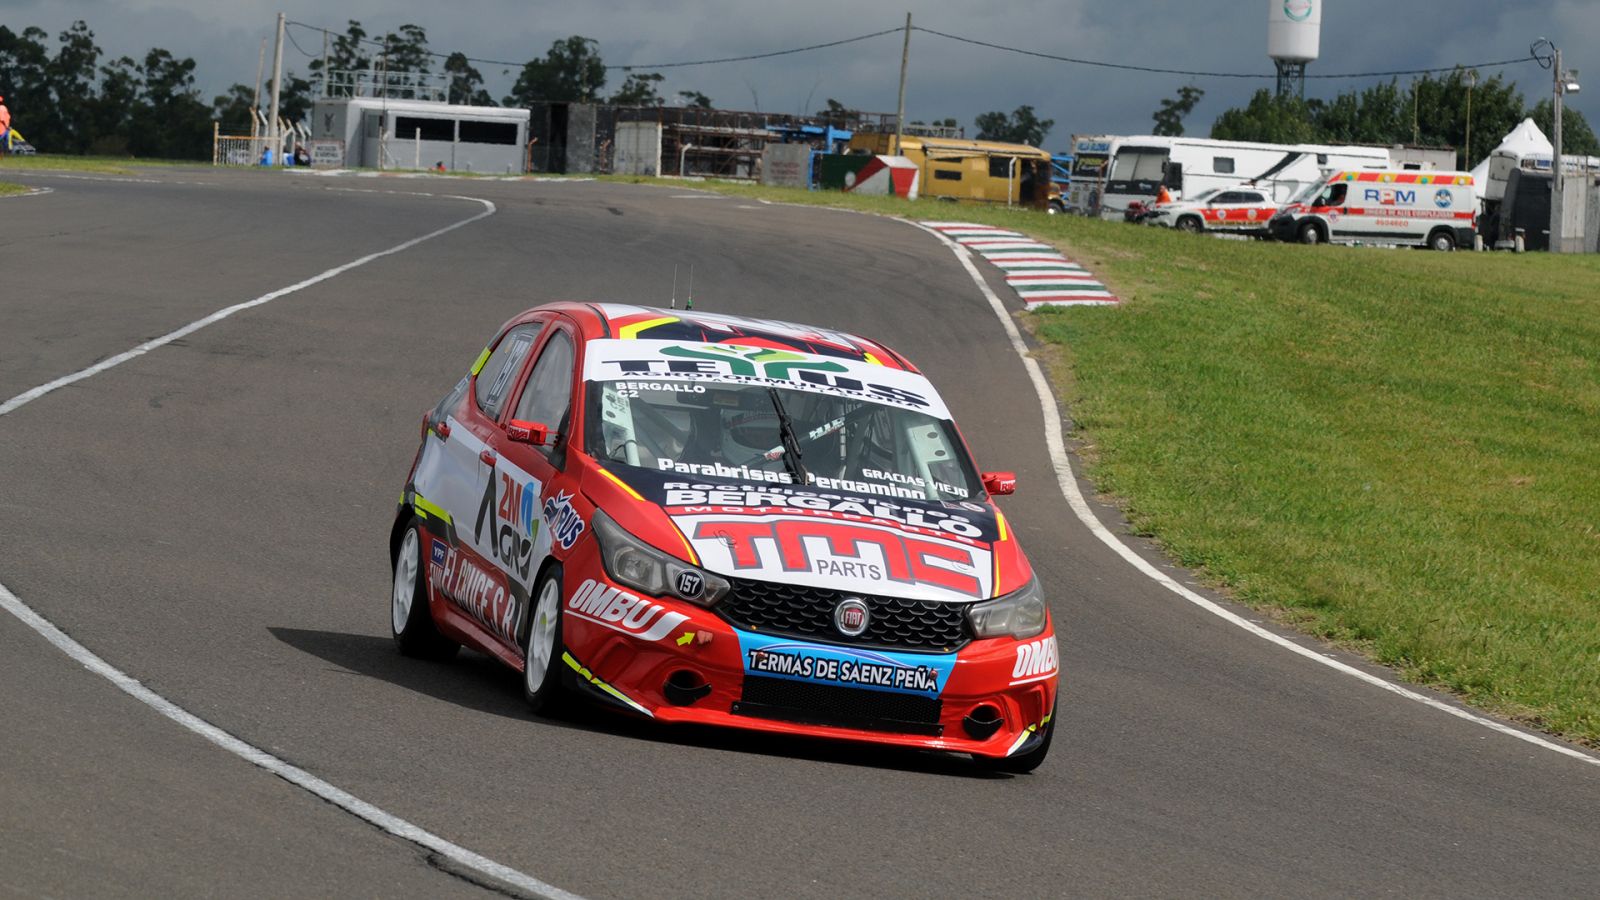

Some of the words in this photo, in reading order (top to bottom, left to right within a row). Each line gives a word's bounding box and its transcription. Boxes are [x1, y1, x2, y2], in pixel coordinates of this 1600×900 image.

[1364, 188, 1416, 206] RPM
[615, 382, 706, 394] BERGALLO
[617, 390, 639, 398] C2
[657, 457, 793, 484] Parabrisas
[862, 468, 926, 488] GRACIAS
[931, 481, 969, 499] VIEJO
[663, 481, 970, 524] Rectificaciones
[666, 489, 983, 538] BERGALLO
[433, 546, 445, 560] YPF
[816, 559, 882, 581] PARTS
[680, 574, 705, 594] 157
[568, 579, 664, 628] OMBU
[844, 611, 863, 621] FIAT
[750, 651, 813, 676] TERMAS
[815, 659, 836, 678] DE
[840, 664, 894, 686] SAENZ
[895, 668, 938, 690] PEÑA
